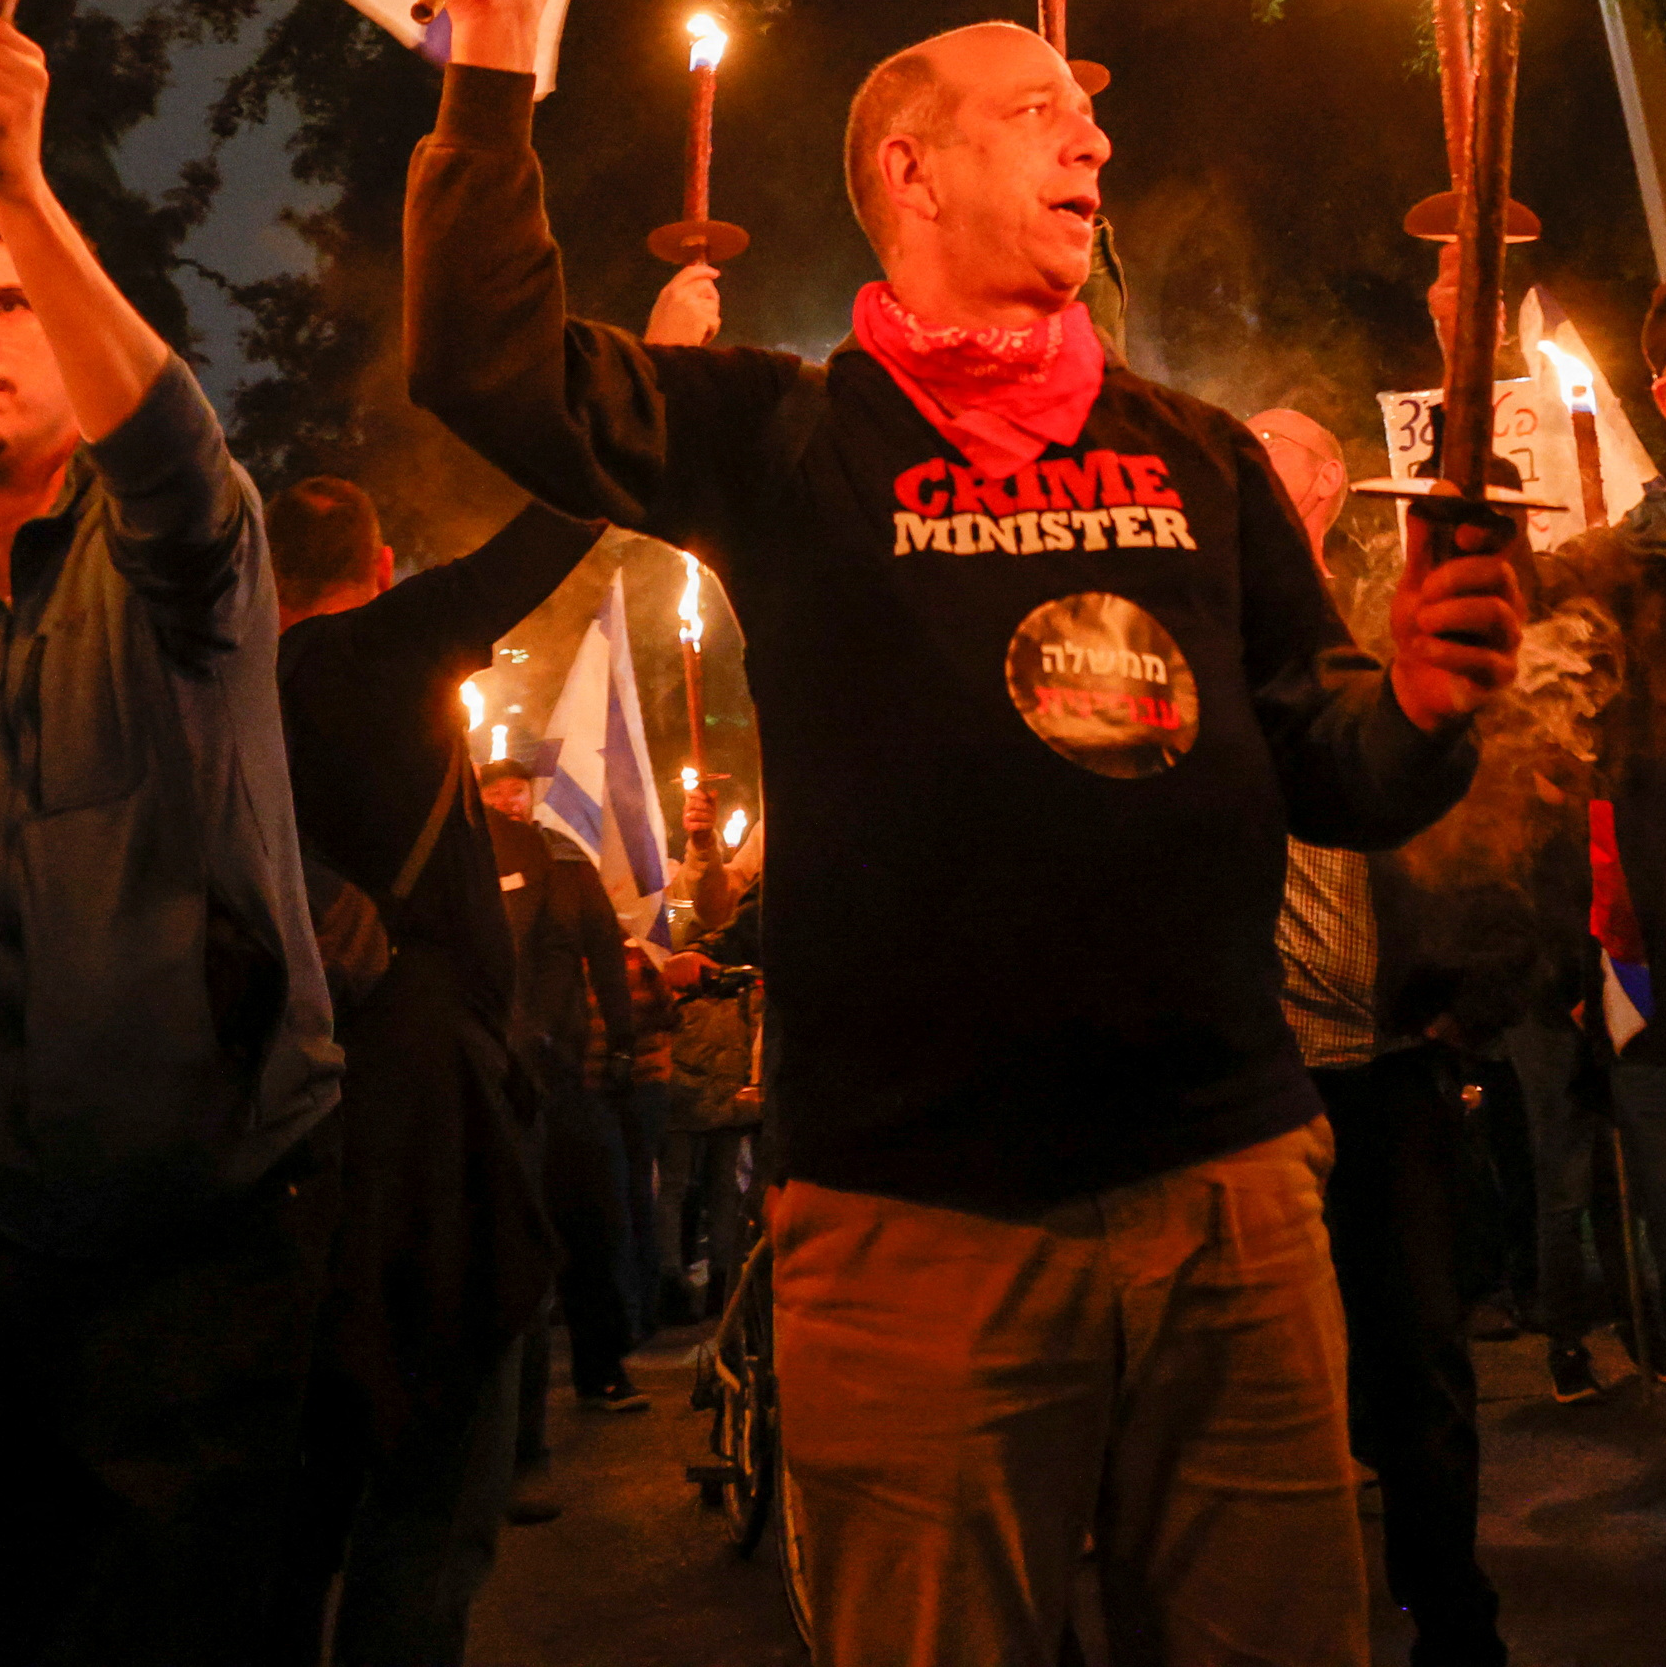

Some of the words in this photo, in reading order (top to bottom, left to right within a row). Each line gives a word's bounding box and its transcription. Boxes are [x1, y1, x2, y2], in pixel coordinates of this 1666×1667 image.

[893, 448, 1183, 518] CRIME
[893, 505, 1199, 557] MINISTER
[1040, 640, 1169, 686] ממשלה
